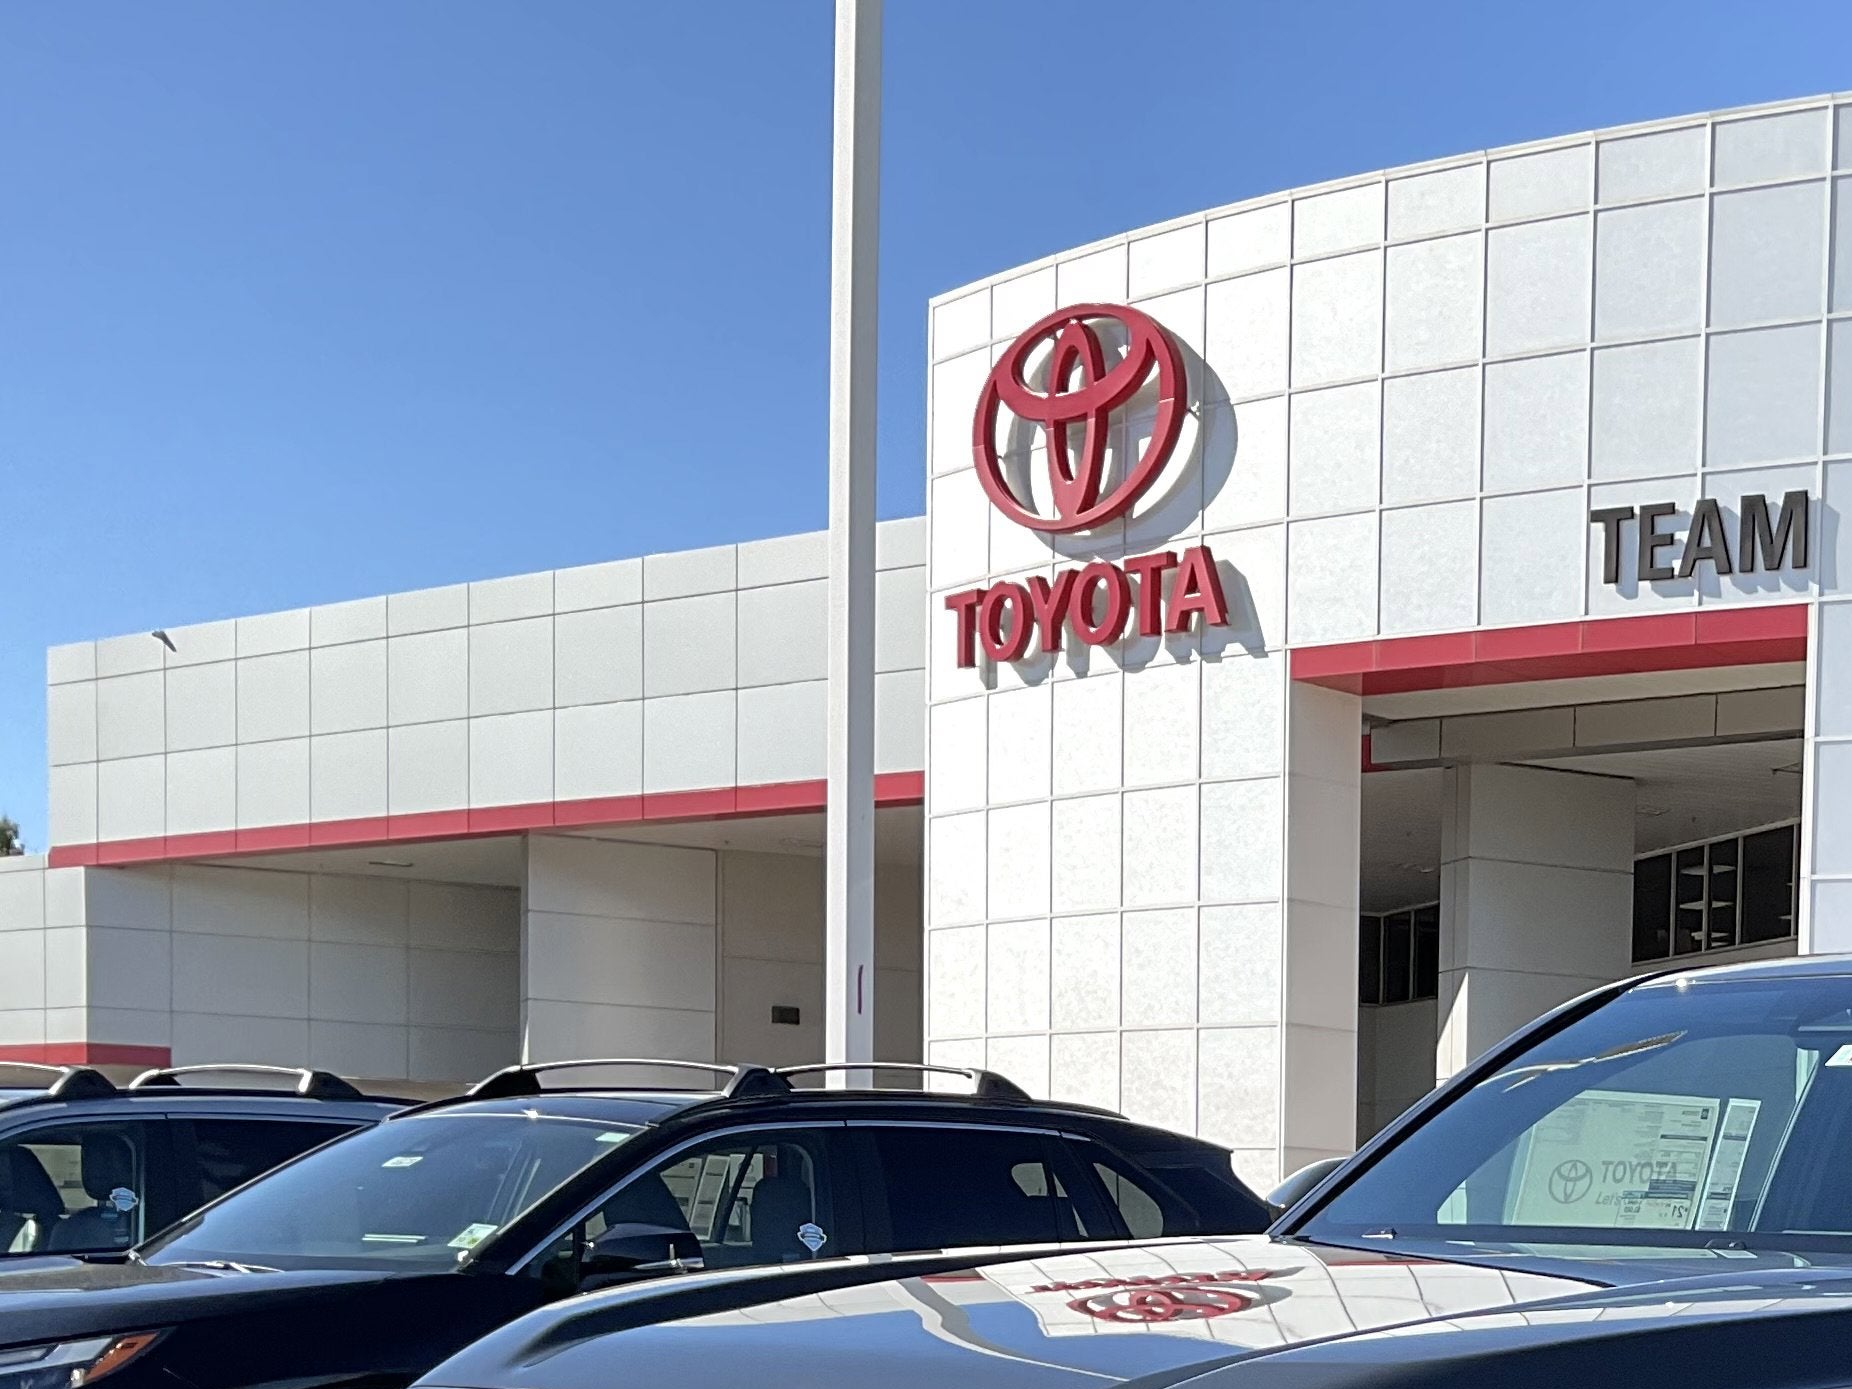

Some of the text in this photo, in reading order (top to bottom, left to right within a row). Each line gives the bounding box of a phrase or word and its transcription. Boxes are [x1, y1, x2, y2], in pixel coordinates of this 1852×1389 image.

[1590, 489, 1808, 584] TEAM
[944, 544, 1231, 668] TOYOTA
[1600, 1160, 1678, 1184] TOYOTA
